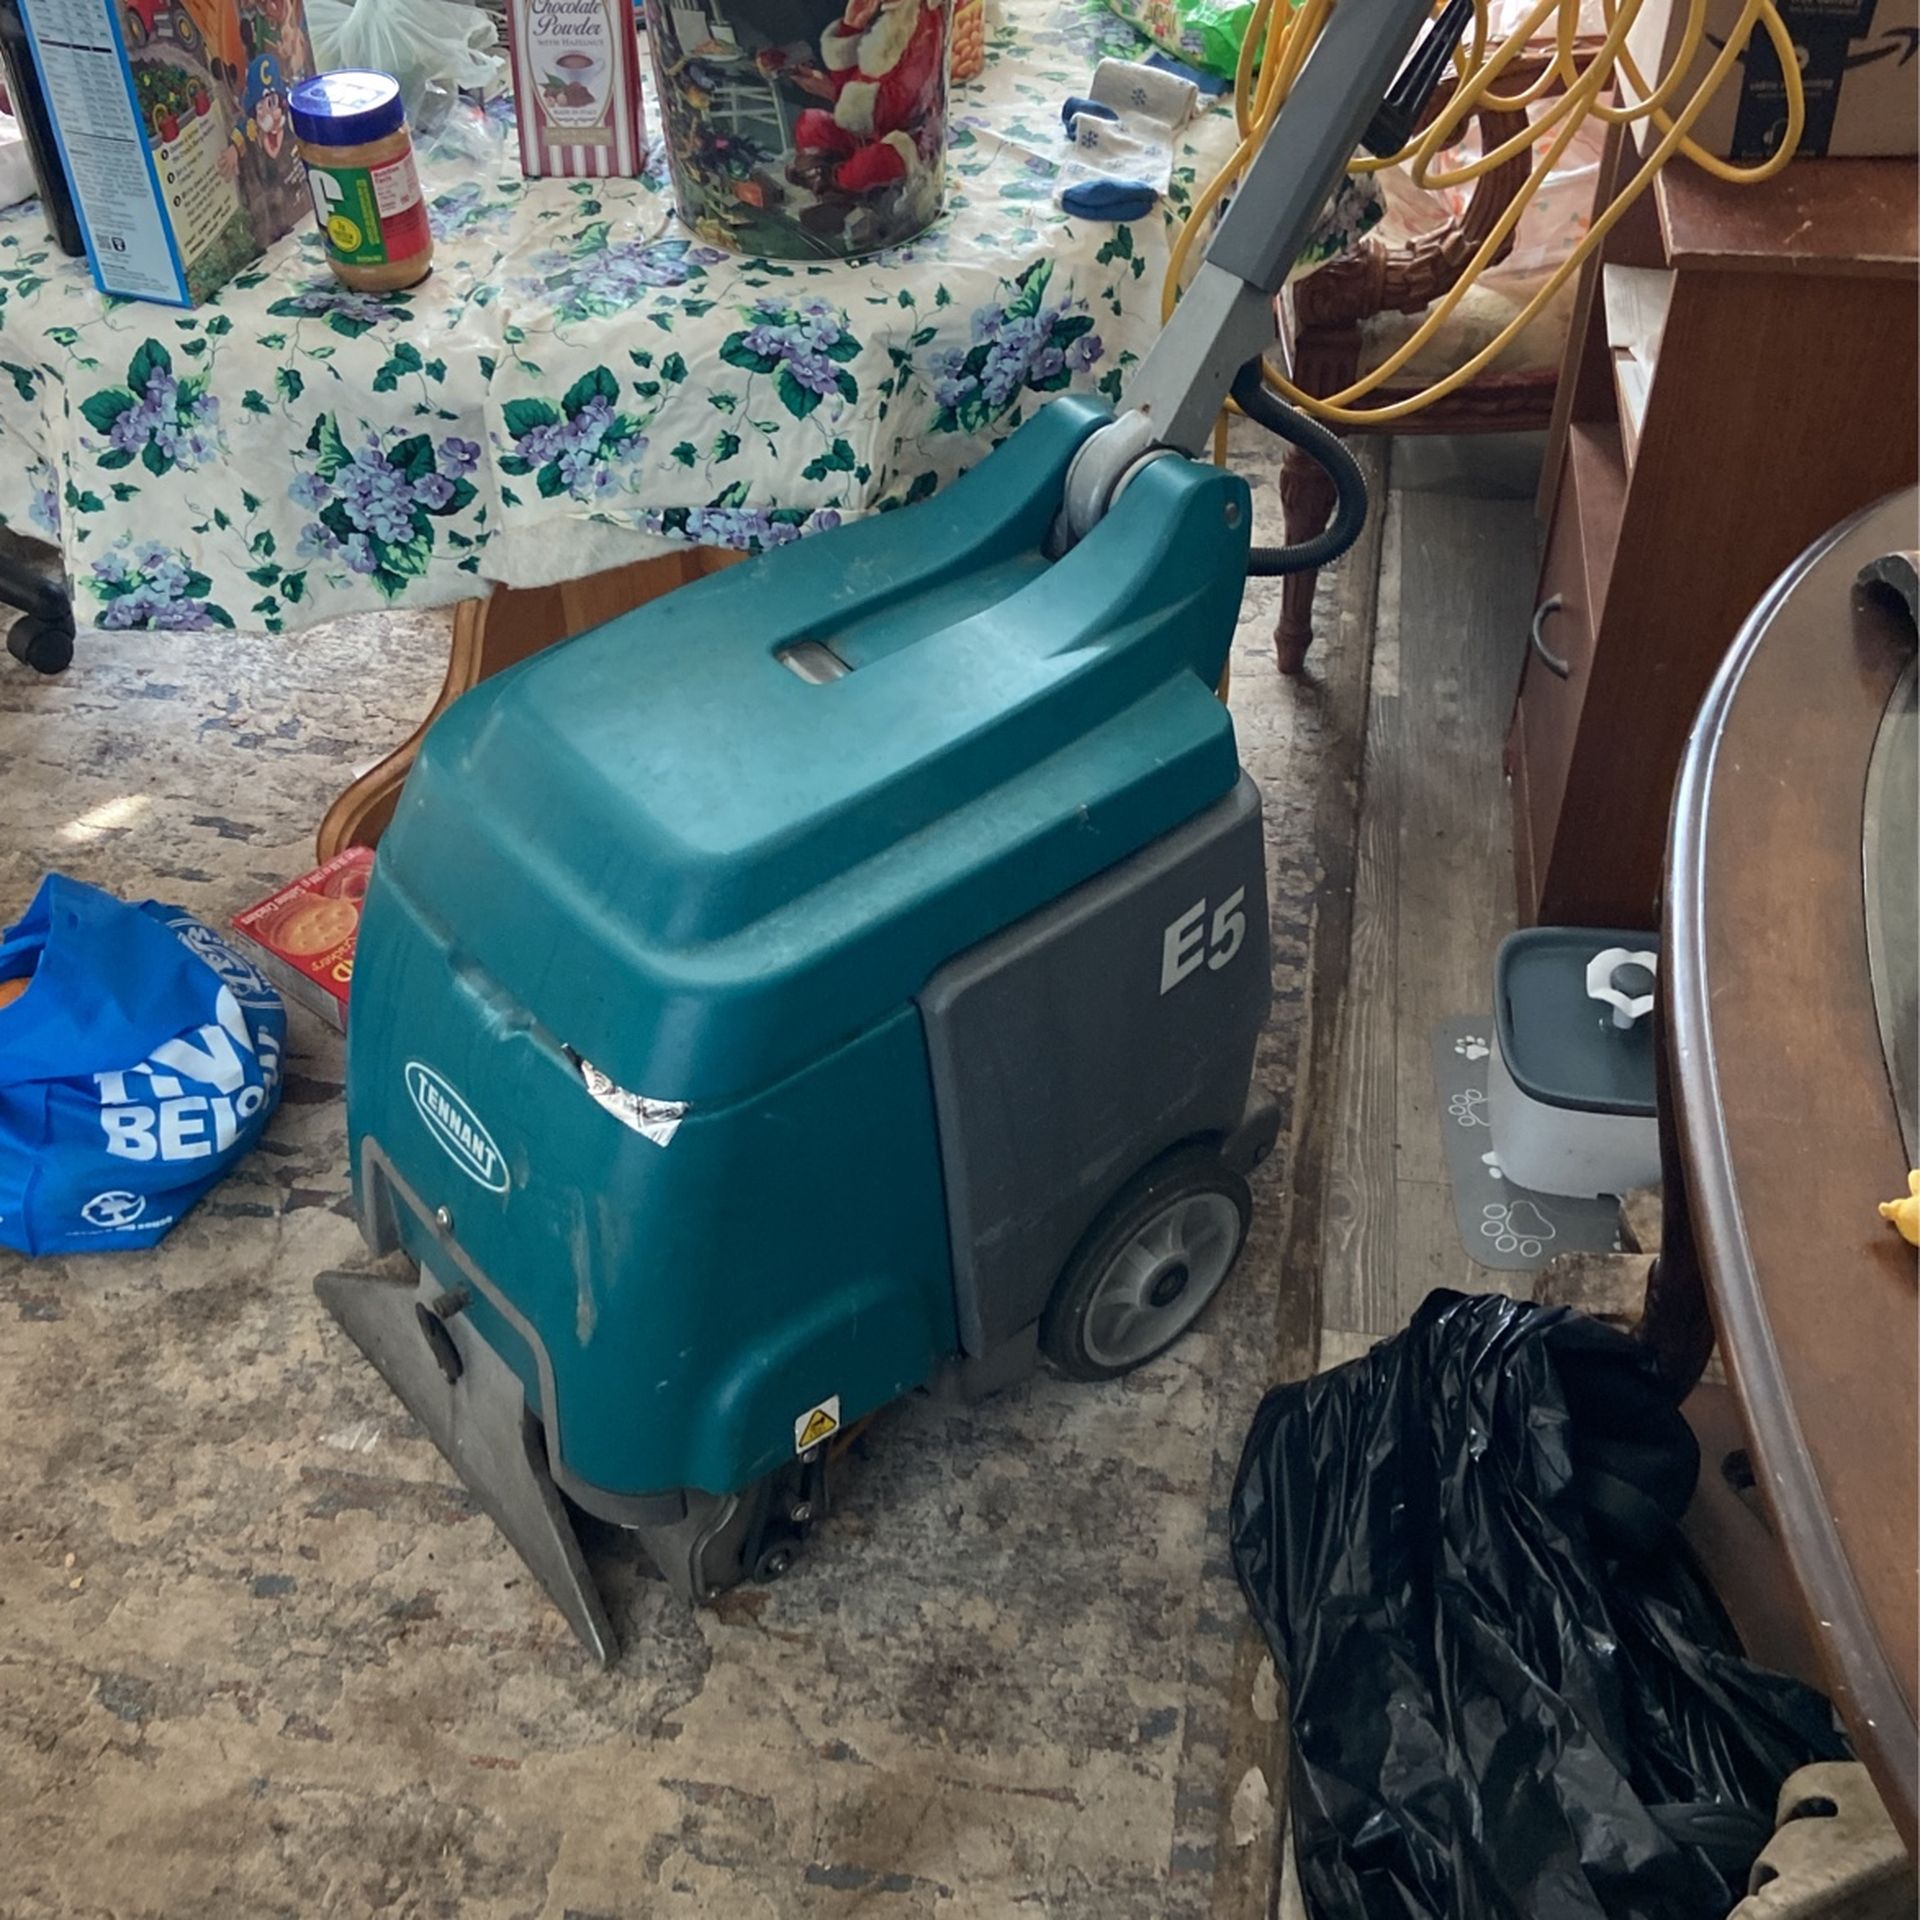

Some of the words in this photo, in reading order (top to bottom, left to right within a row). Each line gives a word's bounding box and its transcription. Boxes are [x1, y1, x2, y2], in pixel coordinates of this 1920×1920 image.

[532, 14, 602, 36] Powder
[1160, 885, 1247, 996] E5
[418, 1072, 497, 1180] TENNANT
